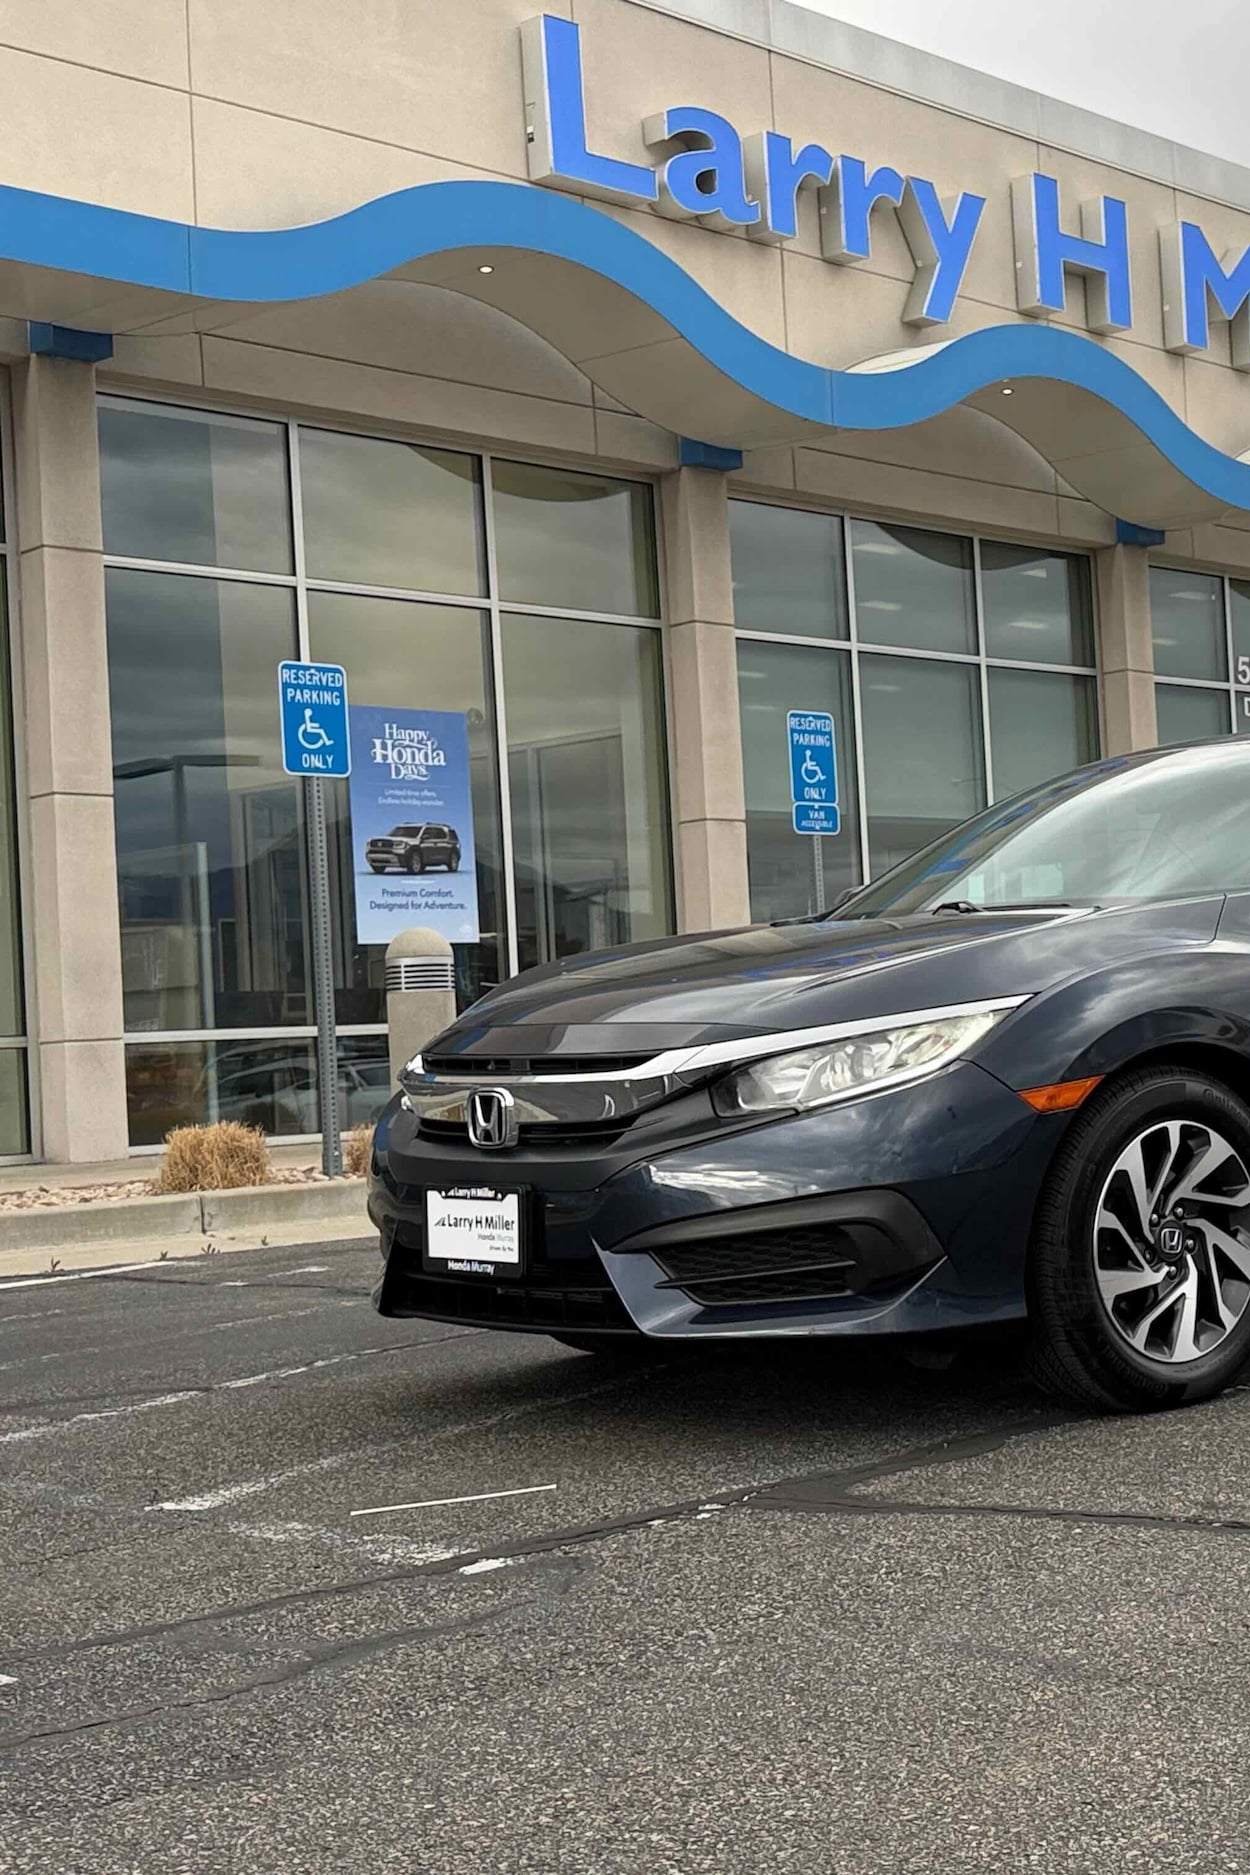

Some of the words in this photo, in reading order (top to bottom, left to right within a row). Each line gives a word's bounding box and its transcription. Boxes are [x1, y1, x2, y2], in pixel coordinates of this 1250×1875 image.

[541, 13, 987, 324] Larry
[1033, 172, 1132, 330] H
[282, 668, 343, 687] RESERVED
[287, 688, 341, 706] PARKING
[790, 716, 832, 732] RESERVED
[384, 723, 430, 746] Happy
[792, 732, 831, 747] PARKING
[371, 738, 447, 766] Honda
[301, 753, 334, 769] ONLY
[803, 787, 827, 800] ONLY
[808, 809, 825, 820] VAN
[381, 888, 418, 898] Premium
[370, 901, 410, 912] Designed
[411, 901, 422, 910] for
[447, 1213, 473, 1232] Larry
[475, 1215, 483, 1229] H
[484, 1215, 515, 1231] Miller
